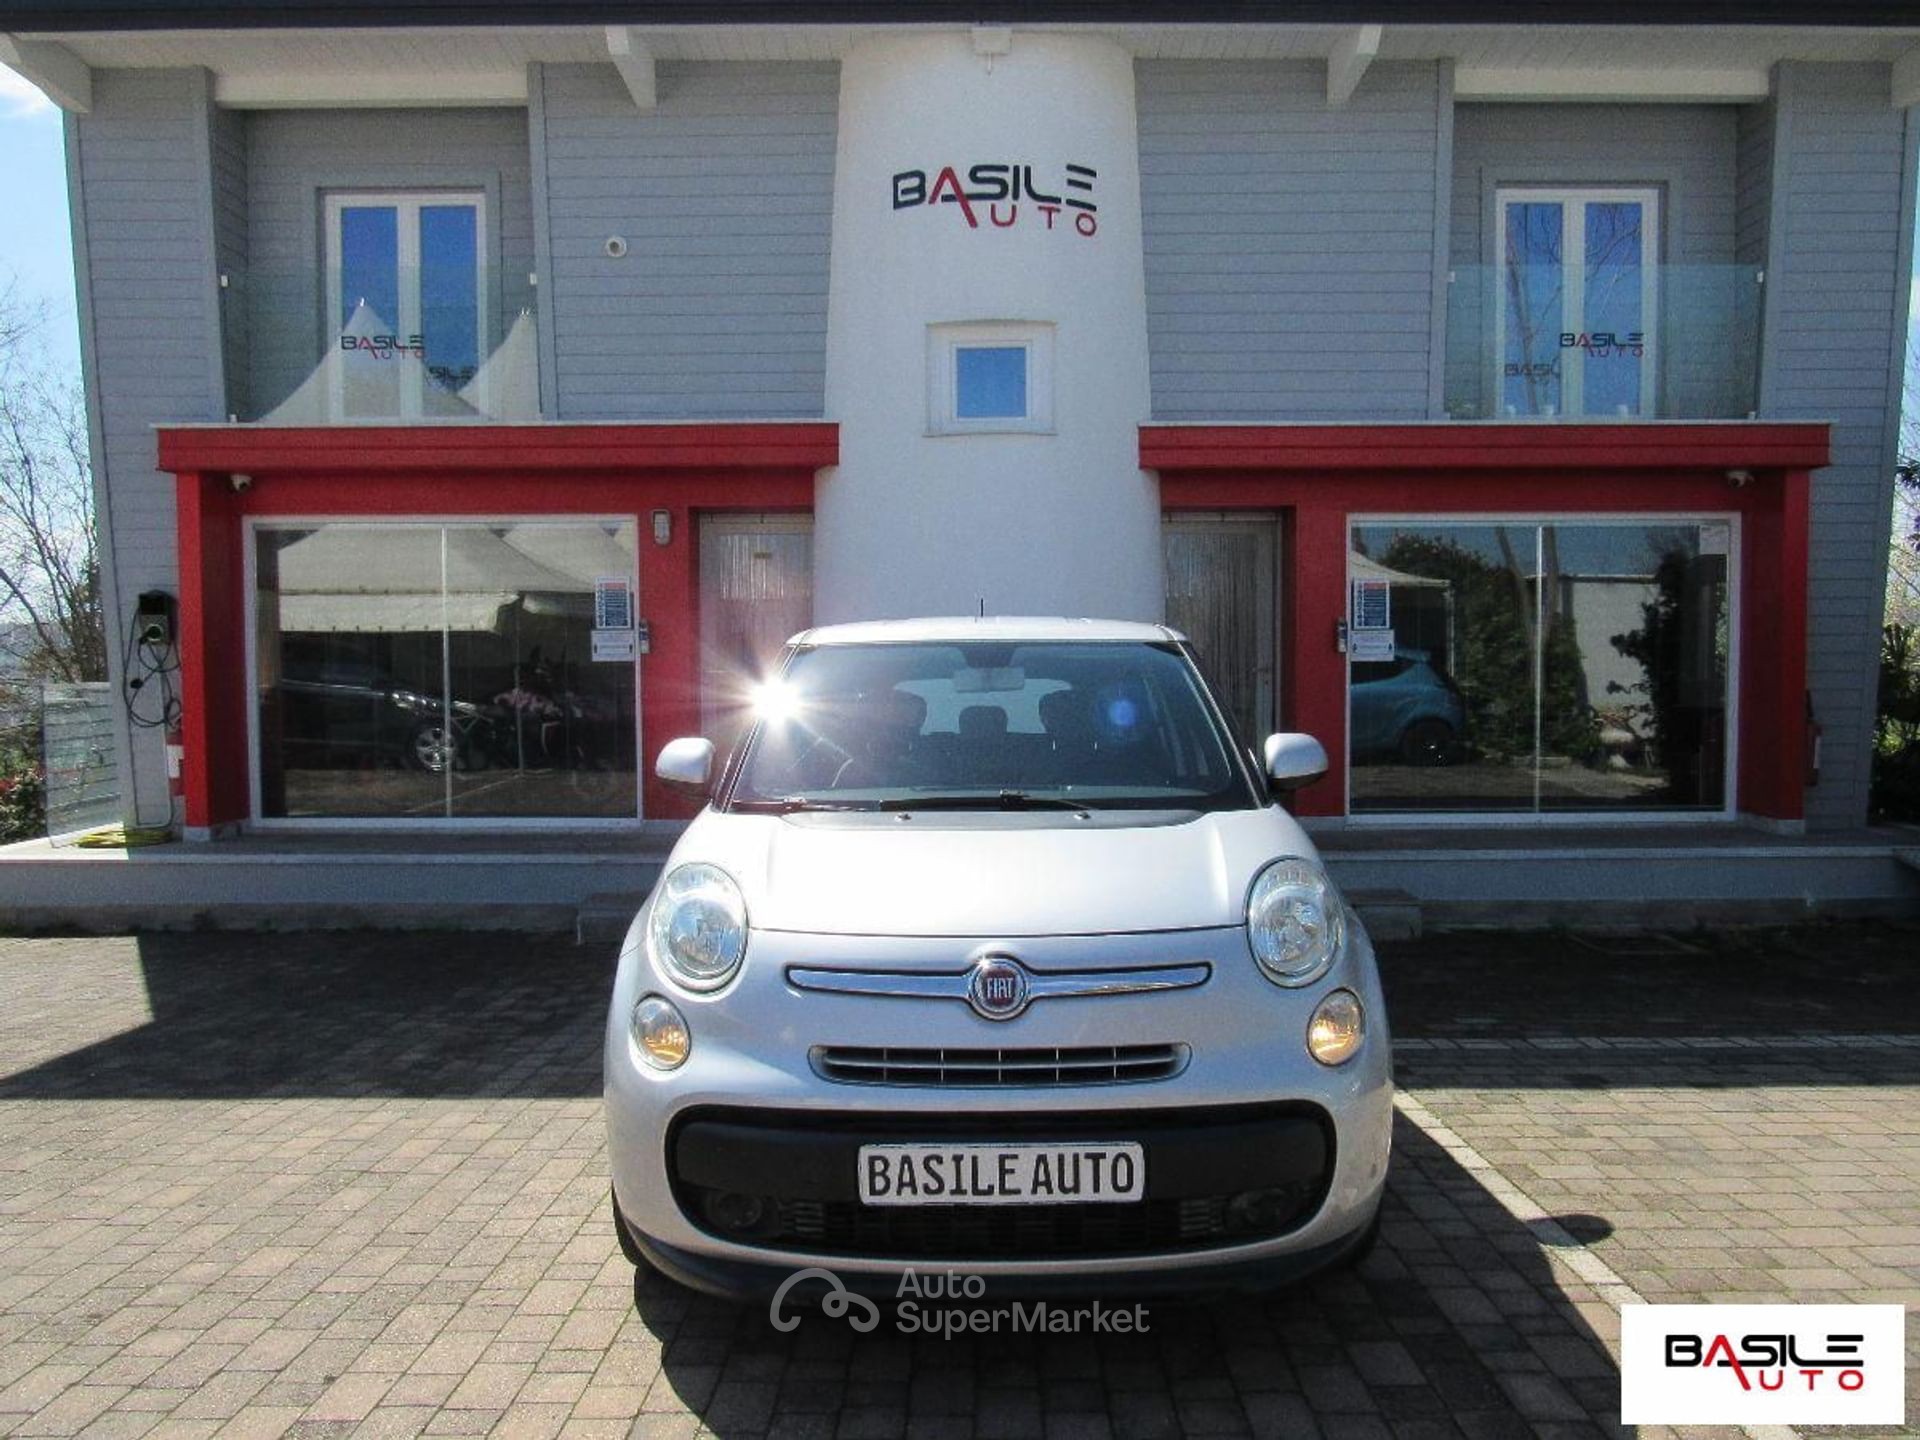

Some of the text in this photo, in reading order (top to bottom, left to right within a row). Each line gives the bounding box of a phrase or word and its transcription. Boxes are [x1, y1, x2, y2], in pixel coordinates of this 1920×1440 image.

[893, 164, 1097, 210] BASILE
[341, 335, 425, 350] BASILE
[1559, 333, 1644, 347] BASILE
[986, 977, 1014, 999] FIAT
[867, 1152, 1134, 1196] BASILE AUTO
